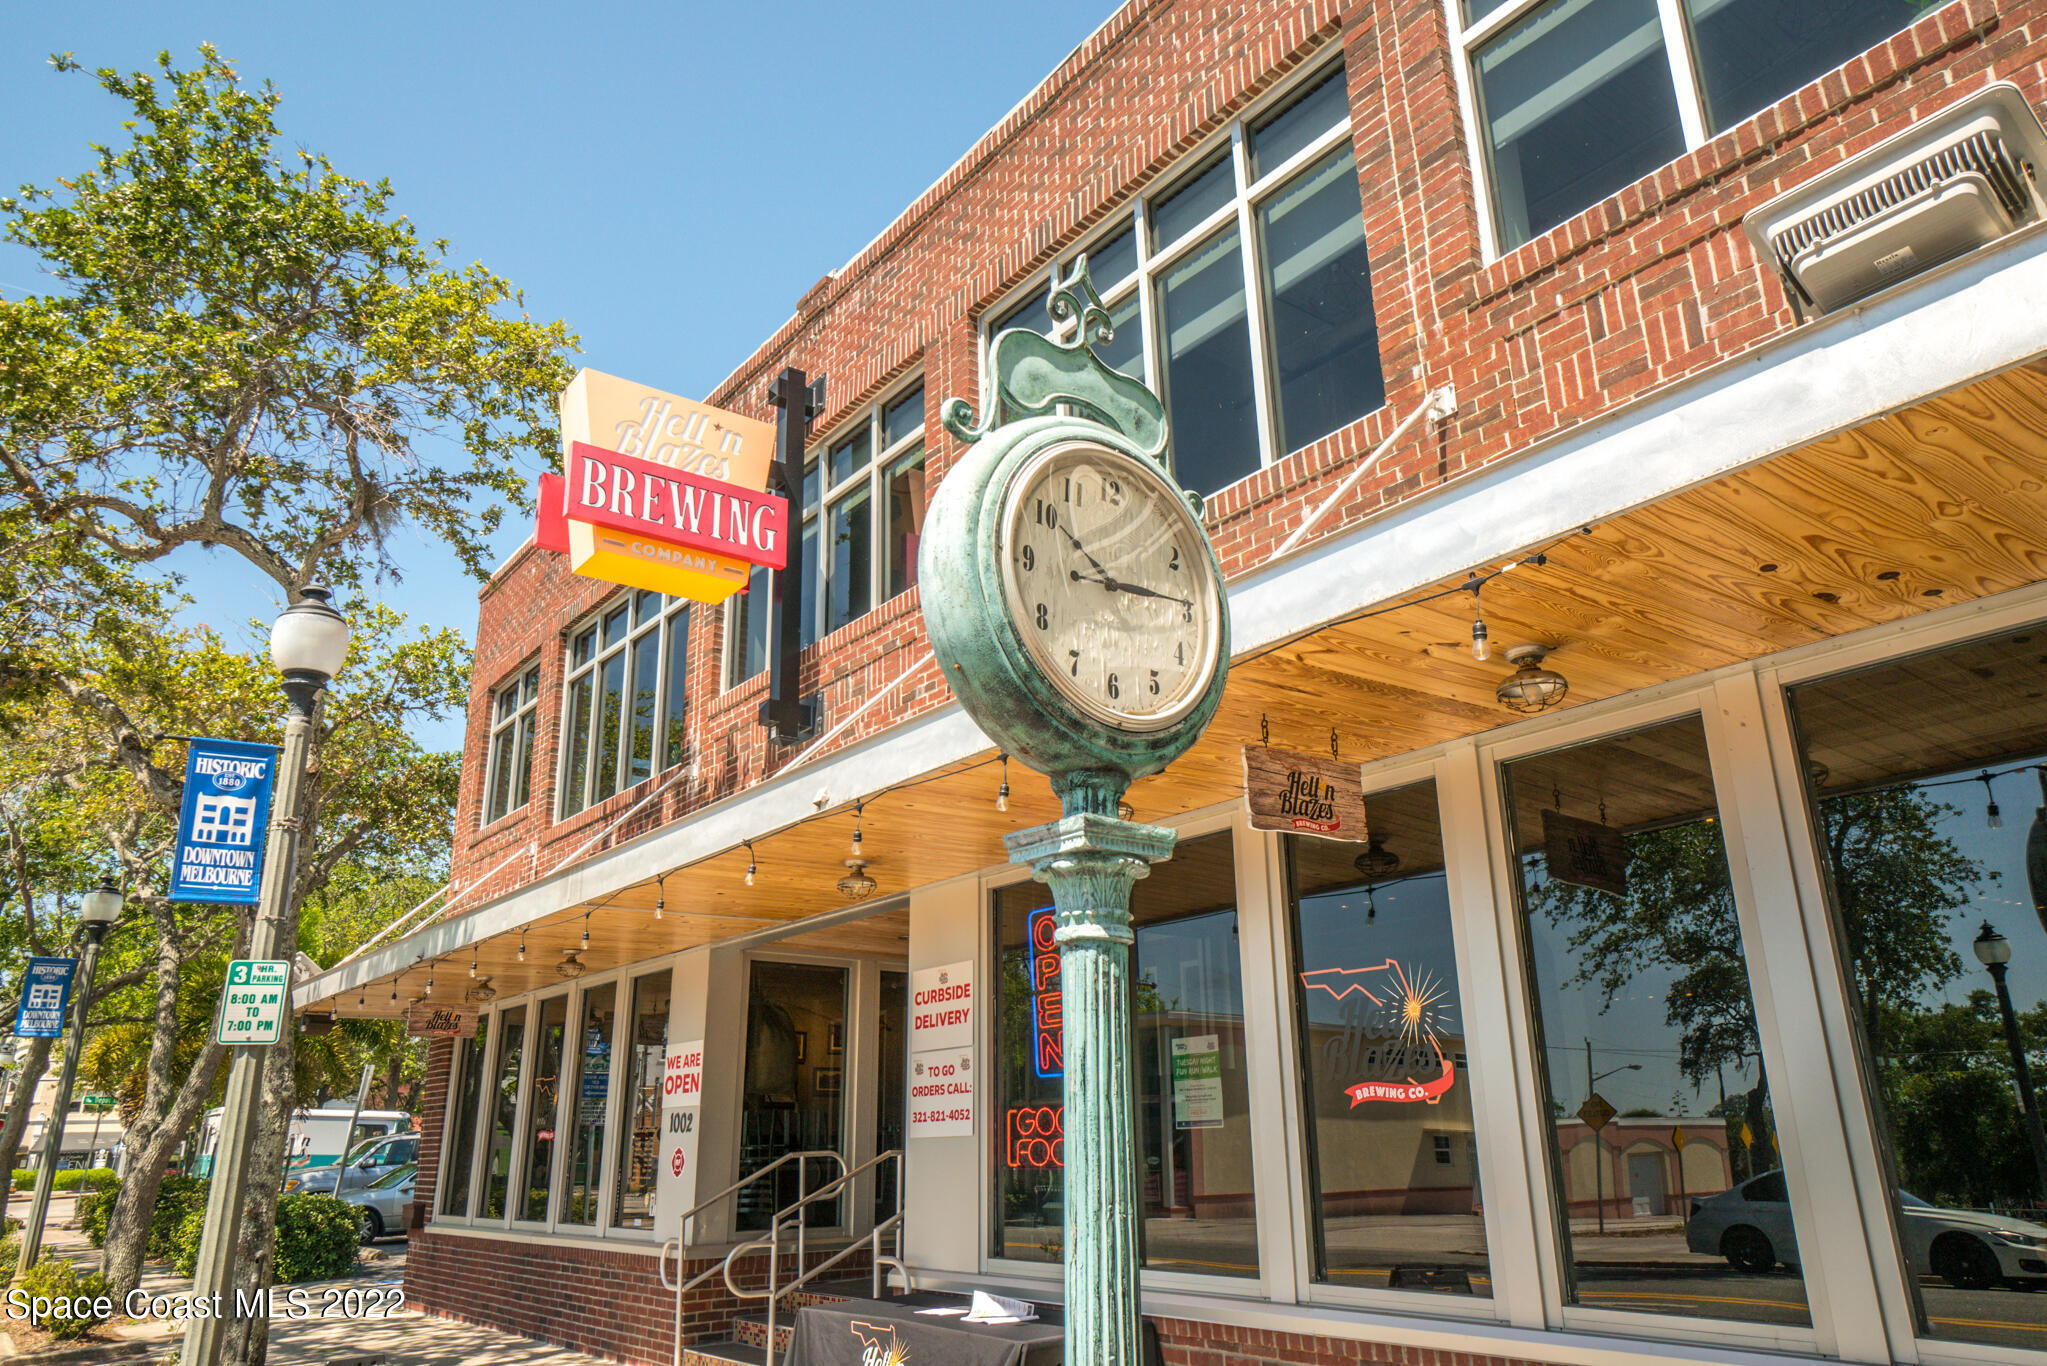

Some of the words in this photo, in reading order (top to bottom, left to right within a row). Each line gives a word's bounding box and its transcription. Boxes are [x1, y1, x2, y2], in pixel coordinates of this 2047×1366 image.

[614, 420, 731, 482] Blazes
[578, 455, 778, 552] BREWING
[1063, 477, 1083, 508] 11
[1102, 477, 1121, 507] 12
[1035, 499, 1059, 531] 10
[631, 541, 718, 573] COMPANY
[1022, 544, 1036, 572] 9
[1169, 546, 1180, 572] 2
[1036, 602, 1049, 631] 8
[1068, 648, 1081, 678] 7
[1173, 640, 1185, 667] 4
[1107, 672, 1120, 700] 6
[1149, 669, 1161, 696] 5
[194, 757, 267, 780] HISTORIC
[218, 777, 241, 787] 1880
[1286, 768, 1320, 799] Hell
[1279, 789, 1334, 821] Blazes
[1295, 820, 1320, 831] BREWING
[182, 846, 255, 868] DOWNTOWN
[179, 864, 254, 886] MELBOURNE
[32, 965, 70, 976] HISTORIC
[233, 965, 248, 984] 3
[252, 975, 284, 983] PARKING
[230, 993, 256, 1005] 8:00
[260, 994, 279, 1005] AM
[914, 983, 971, 1007] CURBSIDE
[1034, 914, 1064, 1071] OPEN
[246, 1006, 260, 1018] TO
[915, 1008, 970, 1030] DELIVERY
[227, 1020, 252, 1032] 7:00
[256, 1020, 273, 1031] PM
[666, 1055, 681, 1071] WE
[682, 1052, 701, 1069] ARE
[928, 1066, 941, 1078] TO
[942, 1064, 955, 1076] GO
[664, 1072, 700, 1096] OPEN
[911, 1084, 946, 1098] ORDERS
[946, 1082, 972, 1096] CALL:
[1355, 1086, 1406, 1100] BREWING
[1408, 1086, 1429, 1099] CO.
[669, 1111, 693, 1134] 1002
[912, 1108, 971, 1124] 321-821-4052
